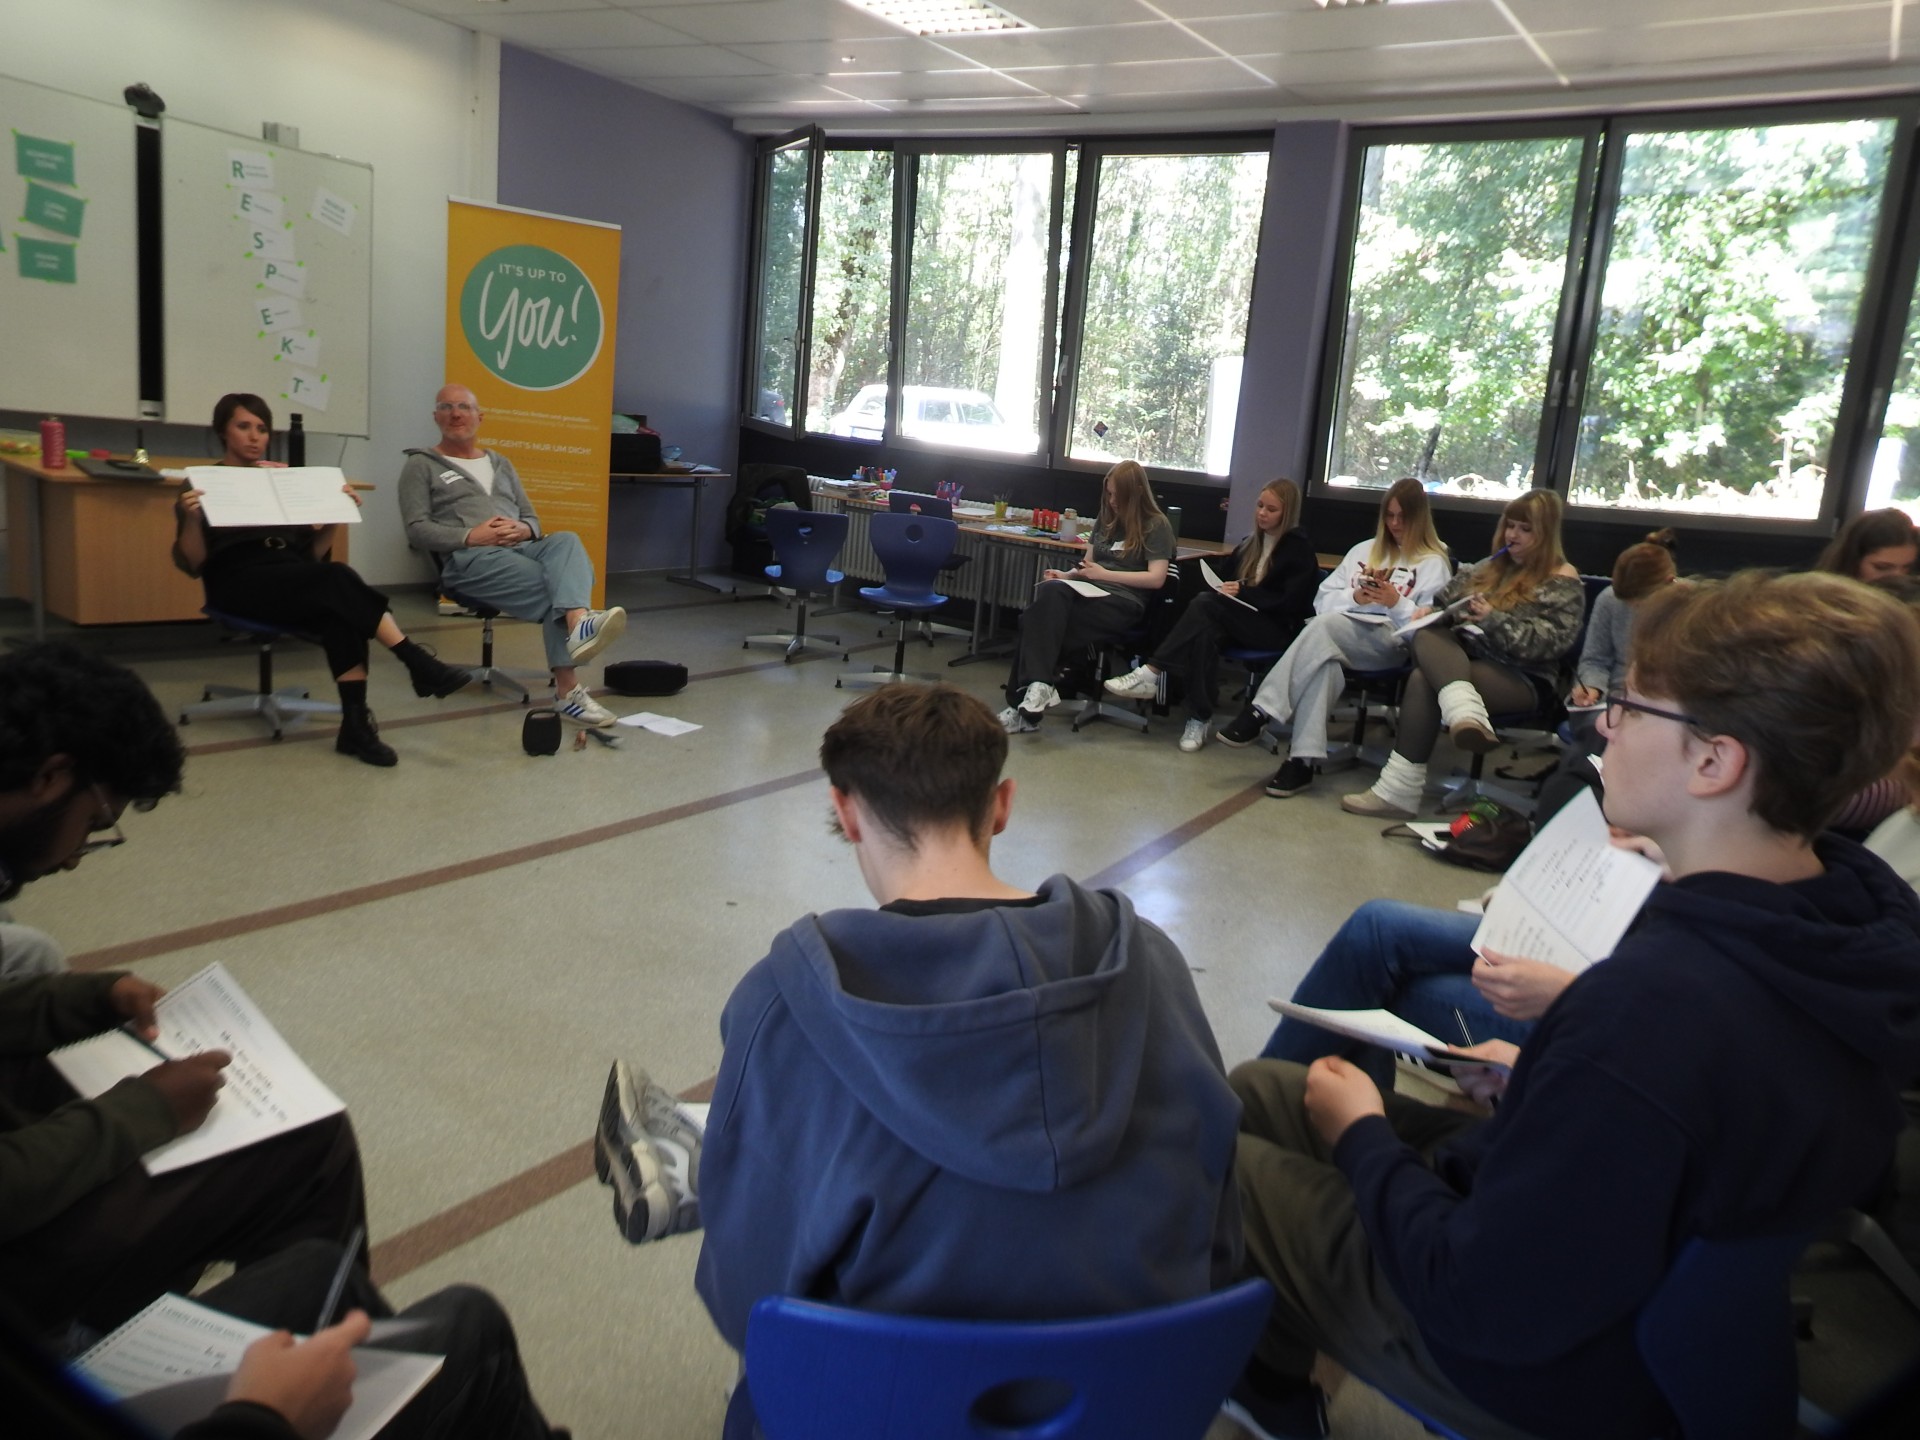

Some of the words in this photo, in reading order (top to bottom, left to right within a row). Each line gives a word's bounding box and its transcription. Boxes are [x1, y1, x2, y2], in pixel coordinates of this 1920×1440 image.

[499, 263, 524, 277] IT'S
[527, 268, 546, 279] UP
[549, 270, 567, 283] TO
[532, 442, 551, 451] NUR
[552, 444, 567, 453] UM
